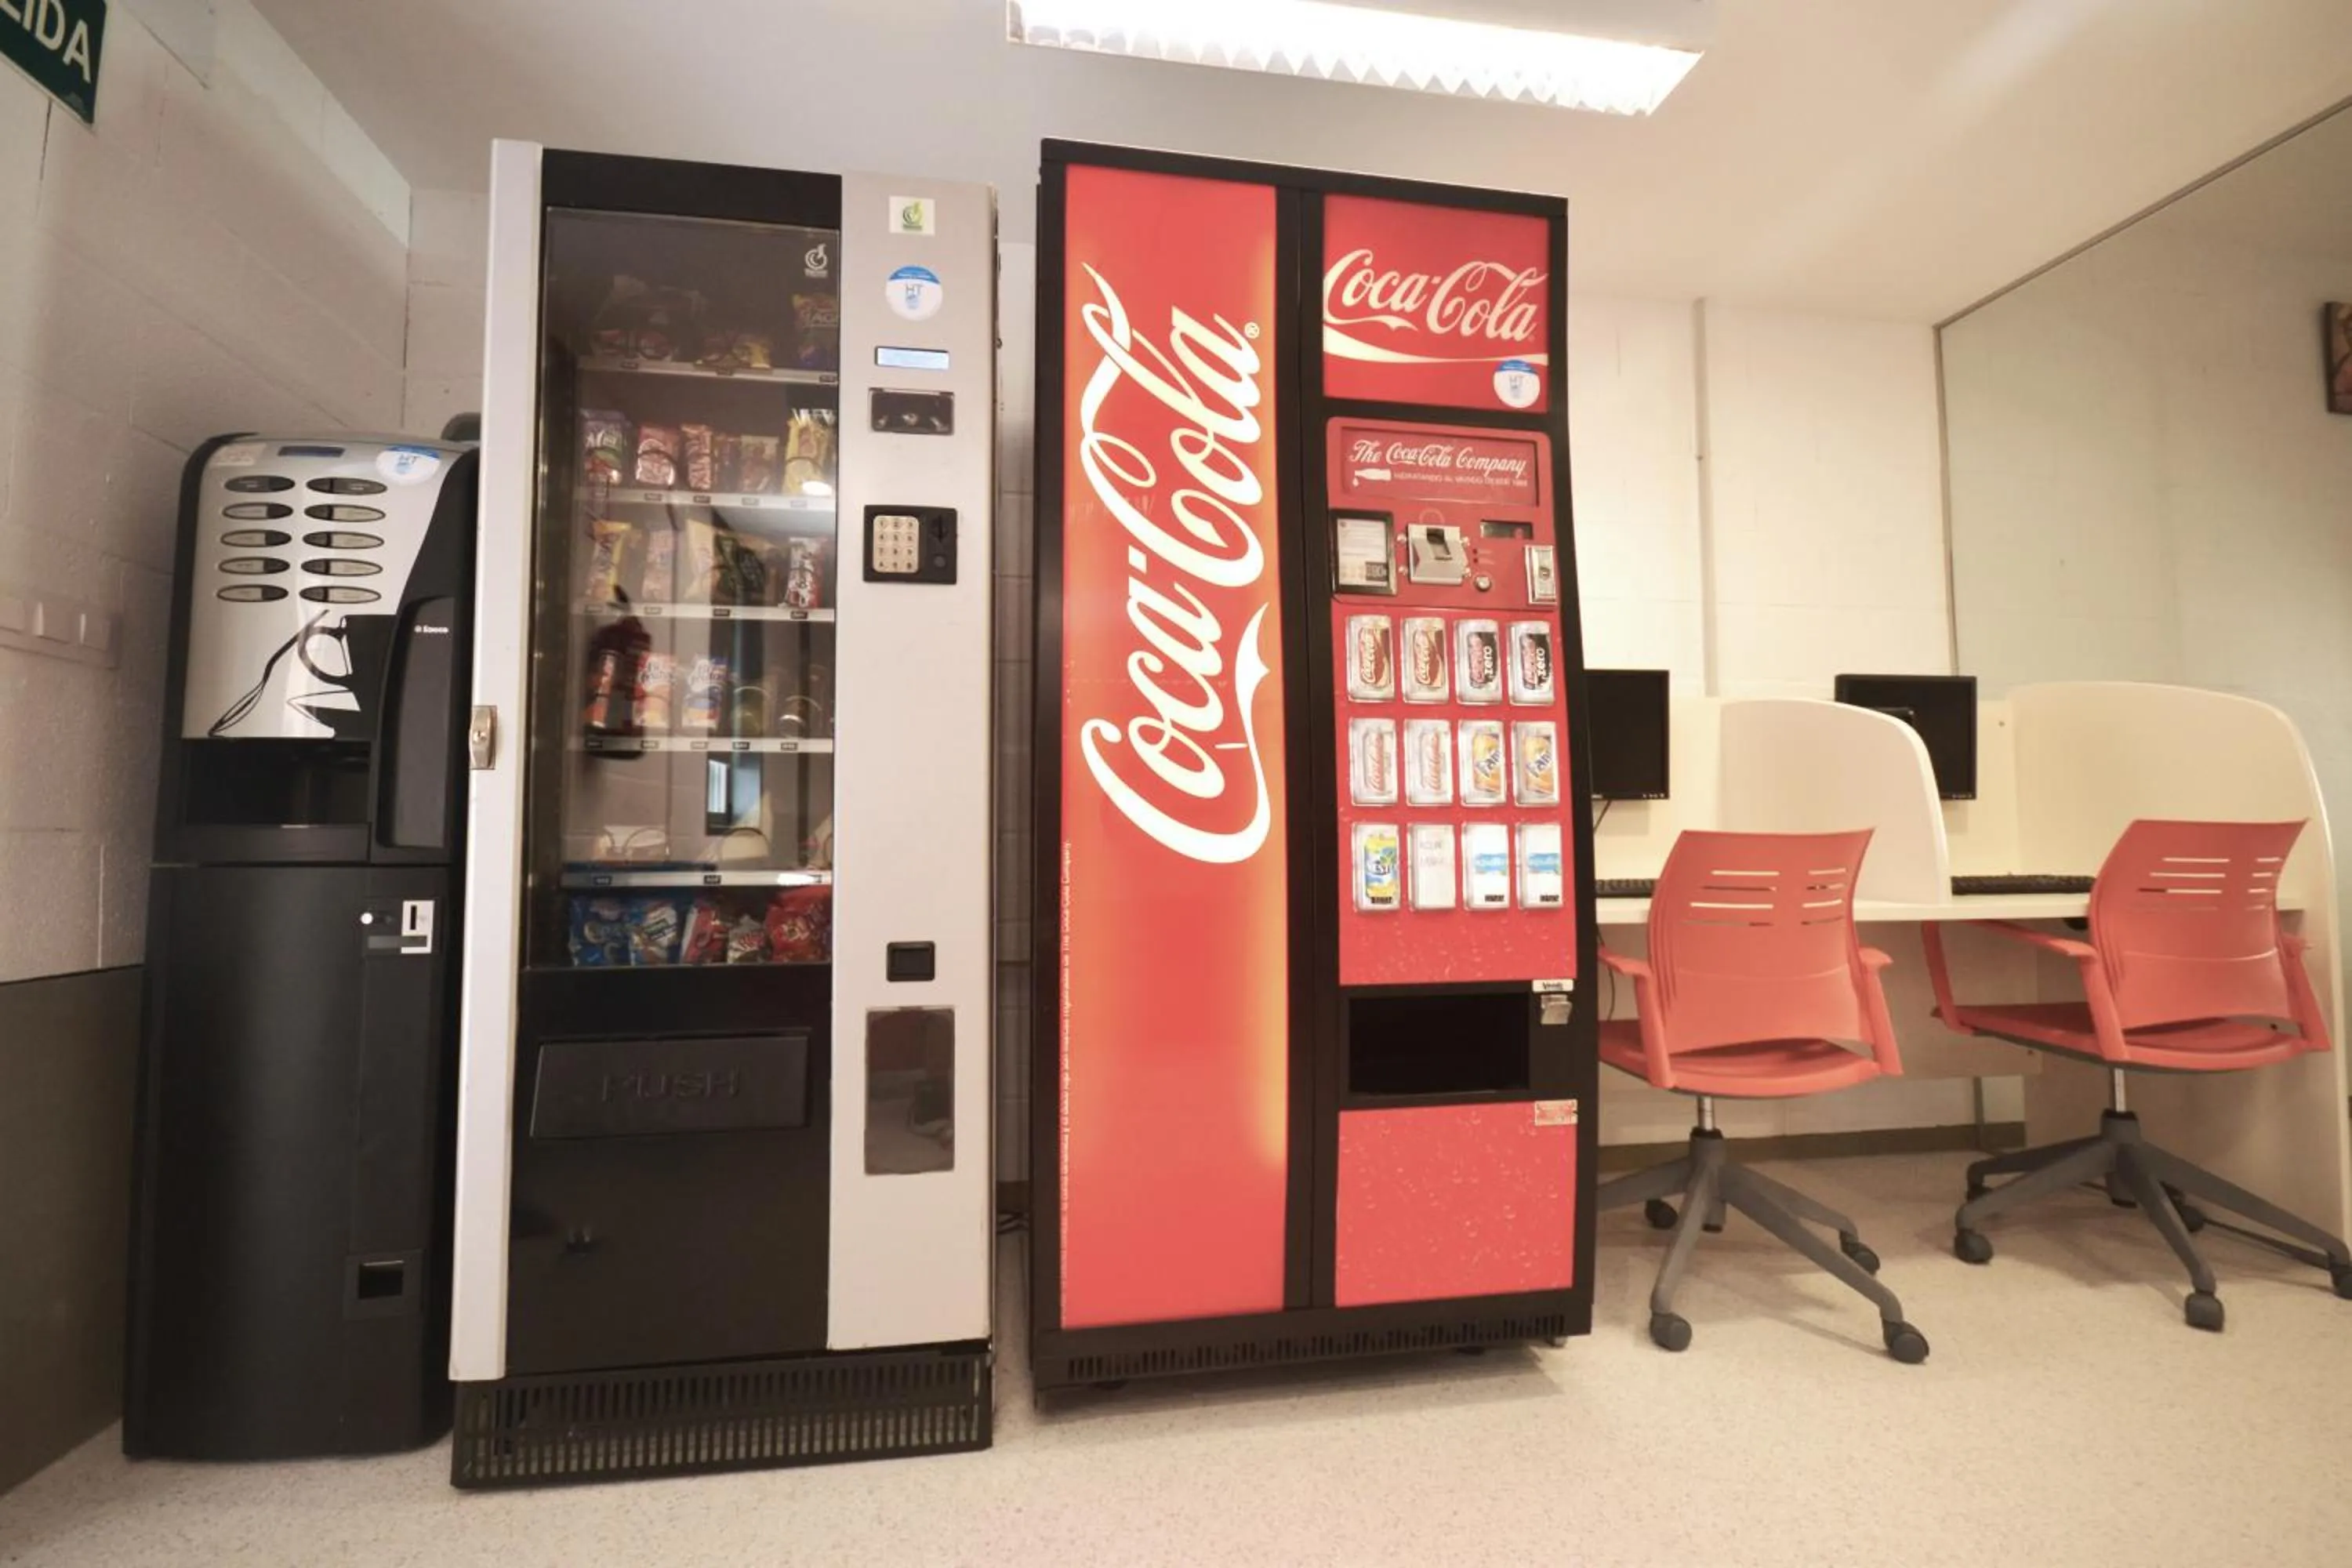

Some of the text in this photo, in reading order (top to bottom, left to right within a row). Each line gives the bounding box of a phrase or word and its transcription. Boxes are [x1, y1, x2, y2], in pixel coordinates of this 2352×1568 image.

[1323, 248, 1548, 343] Coca-Cola
[1348, 439, 1526, 478] The Coca-Cola Company
[1081, 261, 1271, 864] Coca-Cola
[1483, 645, 1494, 675] zero
[1535, 647, 1547, 677] zero
[601, 1069, 741, 1102] PUSH
